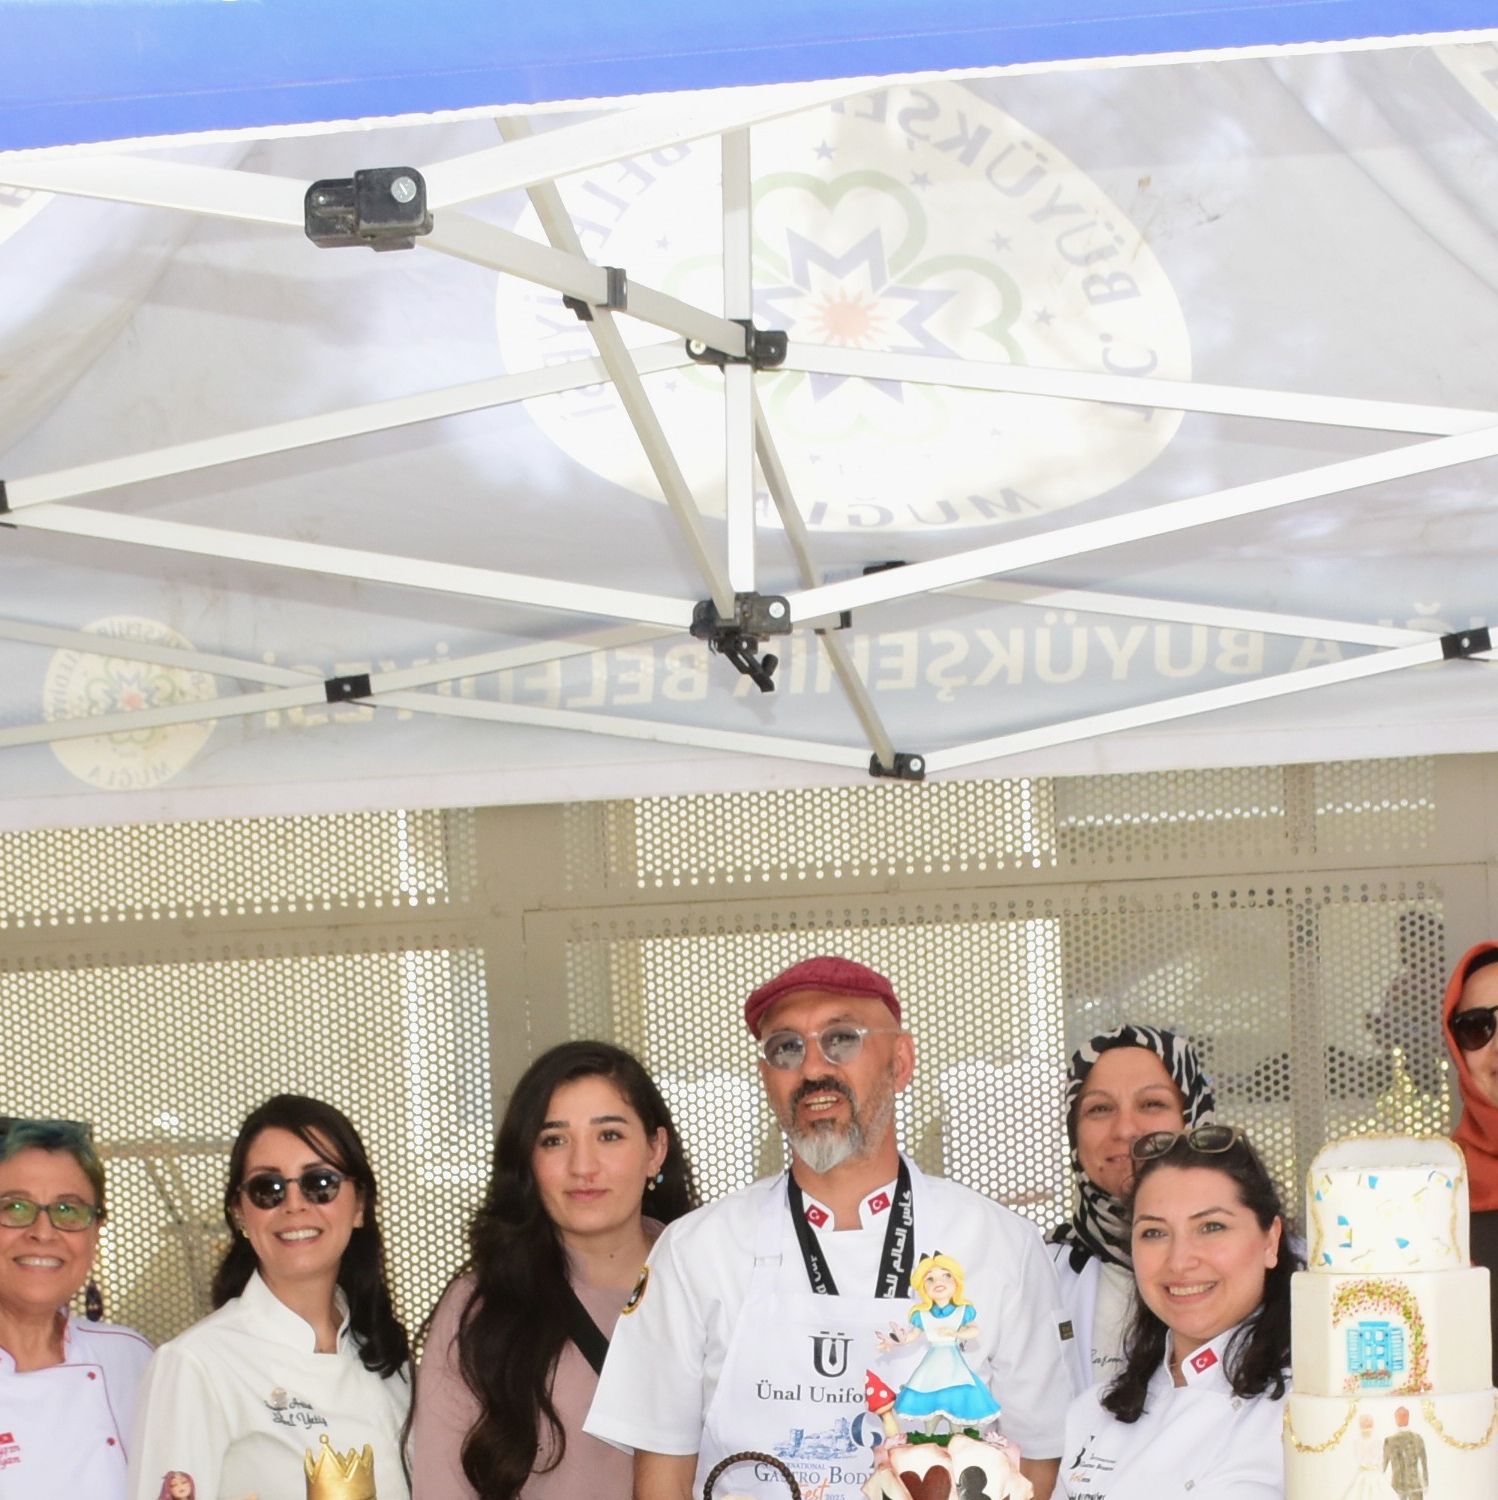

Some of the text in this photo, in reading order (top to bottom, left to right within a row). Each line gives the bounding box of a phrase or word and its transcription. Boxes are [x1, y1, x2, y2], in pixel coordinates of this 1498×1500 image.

[755, 1380, 866, 1403] Ünal Unifo
[829, 1466, 872, 1485] BOD
